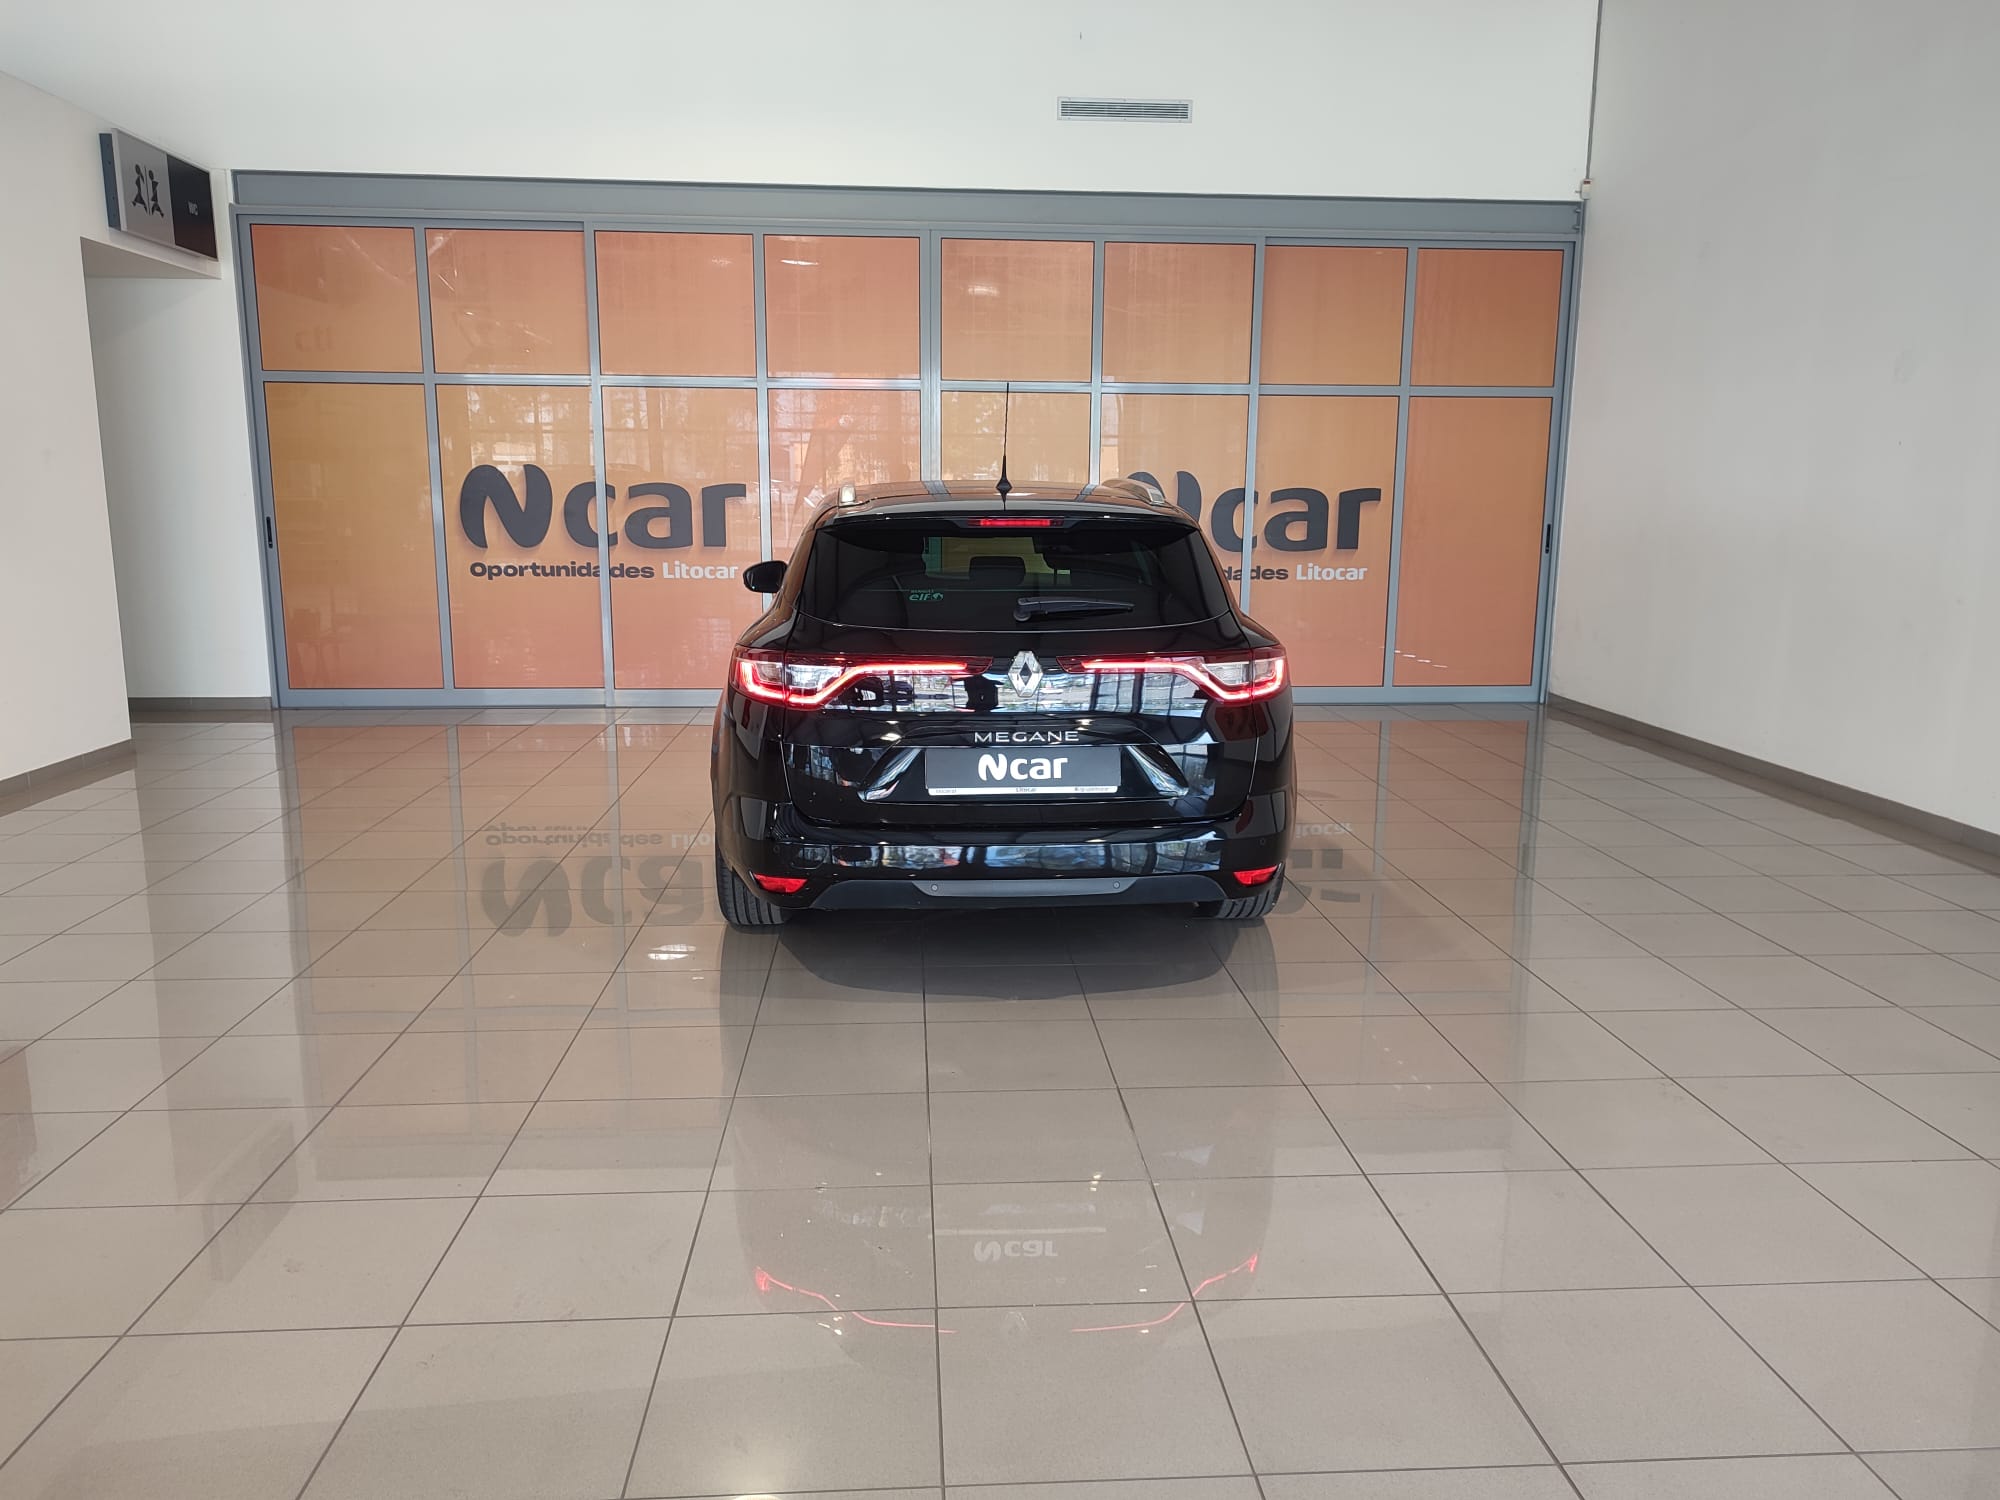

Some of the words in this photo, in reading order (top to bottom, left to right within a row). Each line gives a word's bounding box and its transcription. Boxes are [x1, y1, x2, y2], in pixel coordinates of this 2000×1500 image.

[460, 464, 746, 549] Ncar
[470, 561, 655, 580] Oportunidades
[662, 560, 739, 580] Litocar
[1296, 563, 1368, 581] Litocar
[974, 731, 1080, 743] MEGANE
[977, 753, 1068, 781] Ncar
